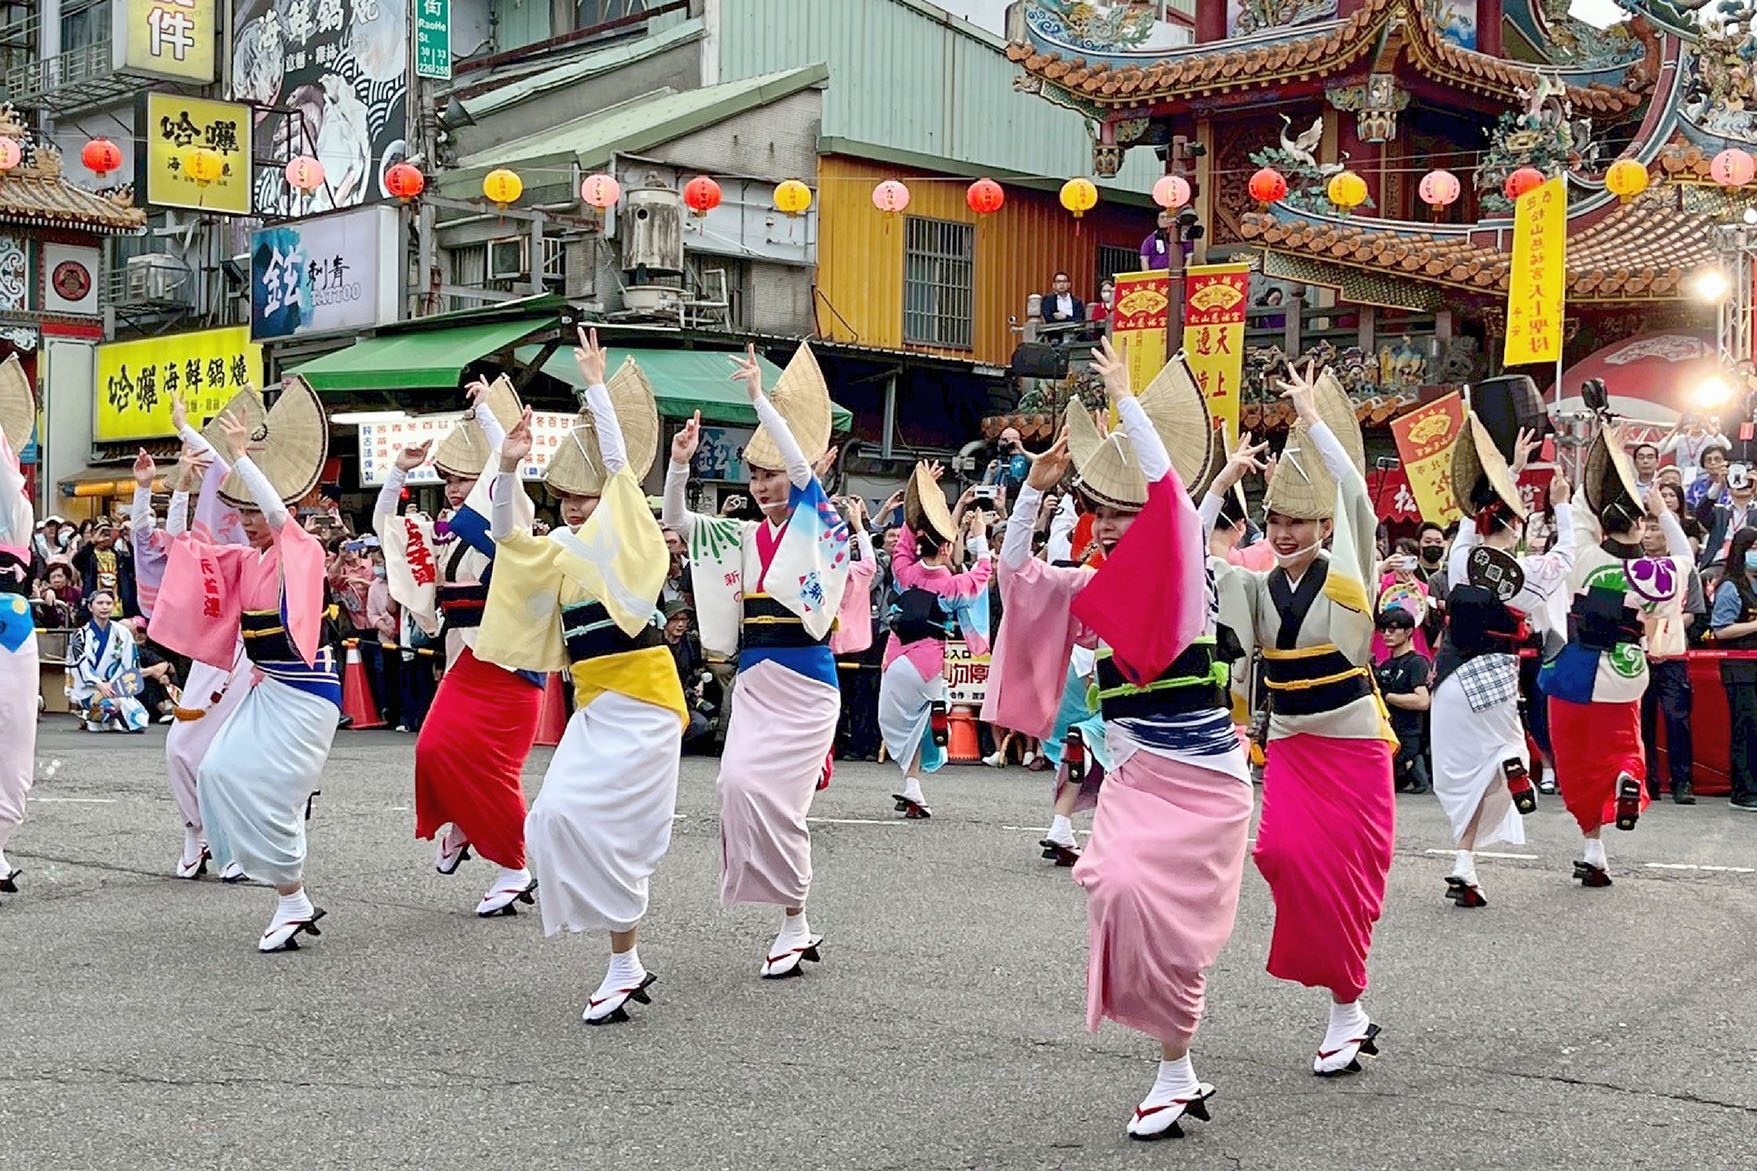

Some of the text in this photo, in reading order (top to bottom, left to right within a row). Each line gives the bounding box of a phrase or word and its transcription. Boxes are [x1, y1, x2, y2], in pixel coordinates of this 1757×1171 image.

[147, 0, 195, 61] 件
[306, 254, 350, 290] 刺青
[311, 283, 361, 307] TATTOO
[948, 663, 990, 688] 勿停
